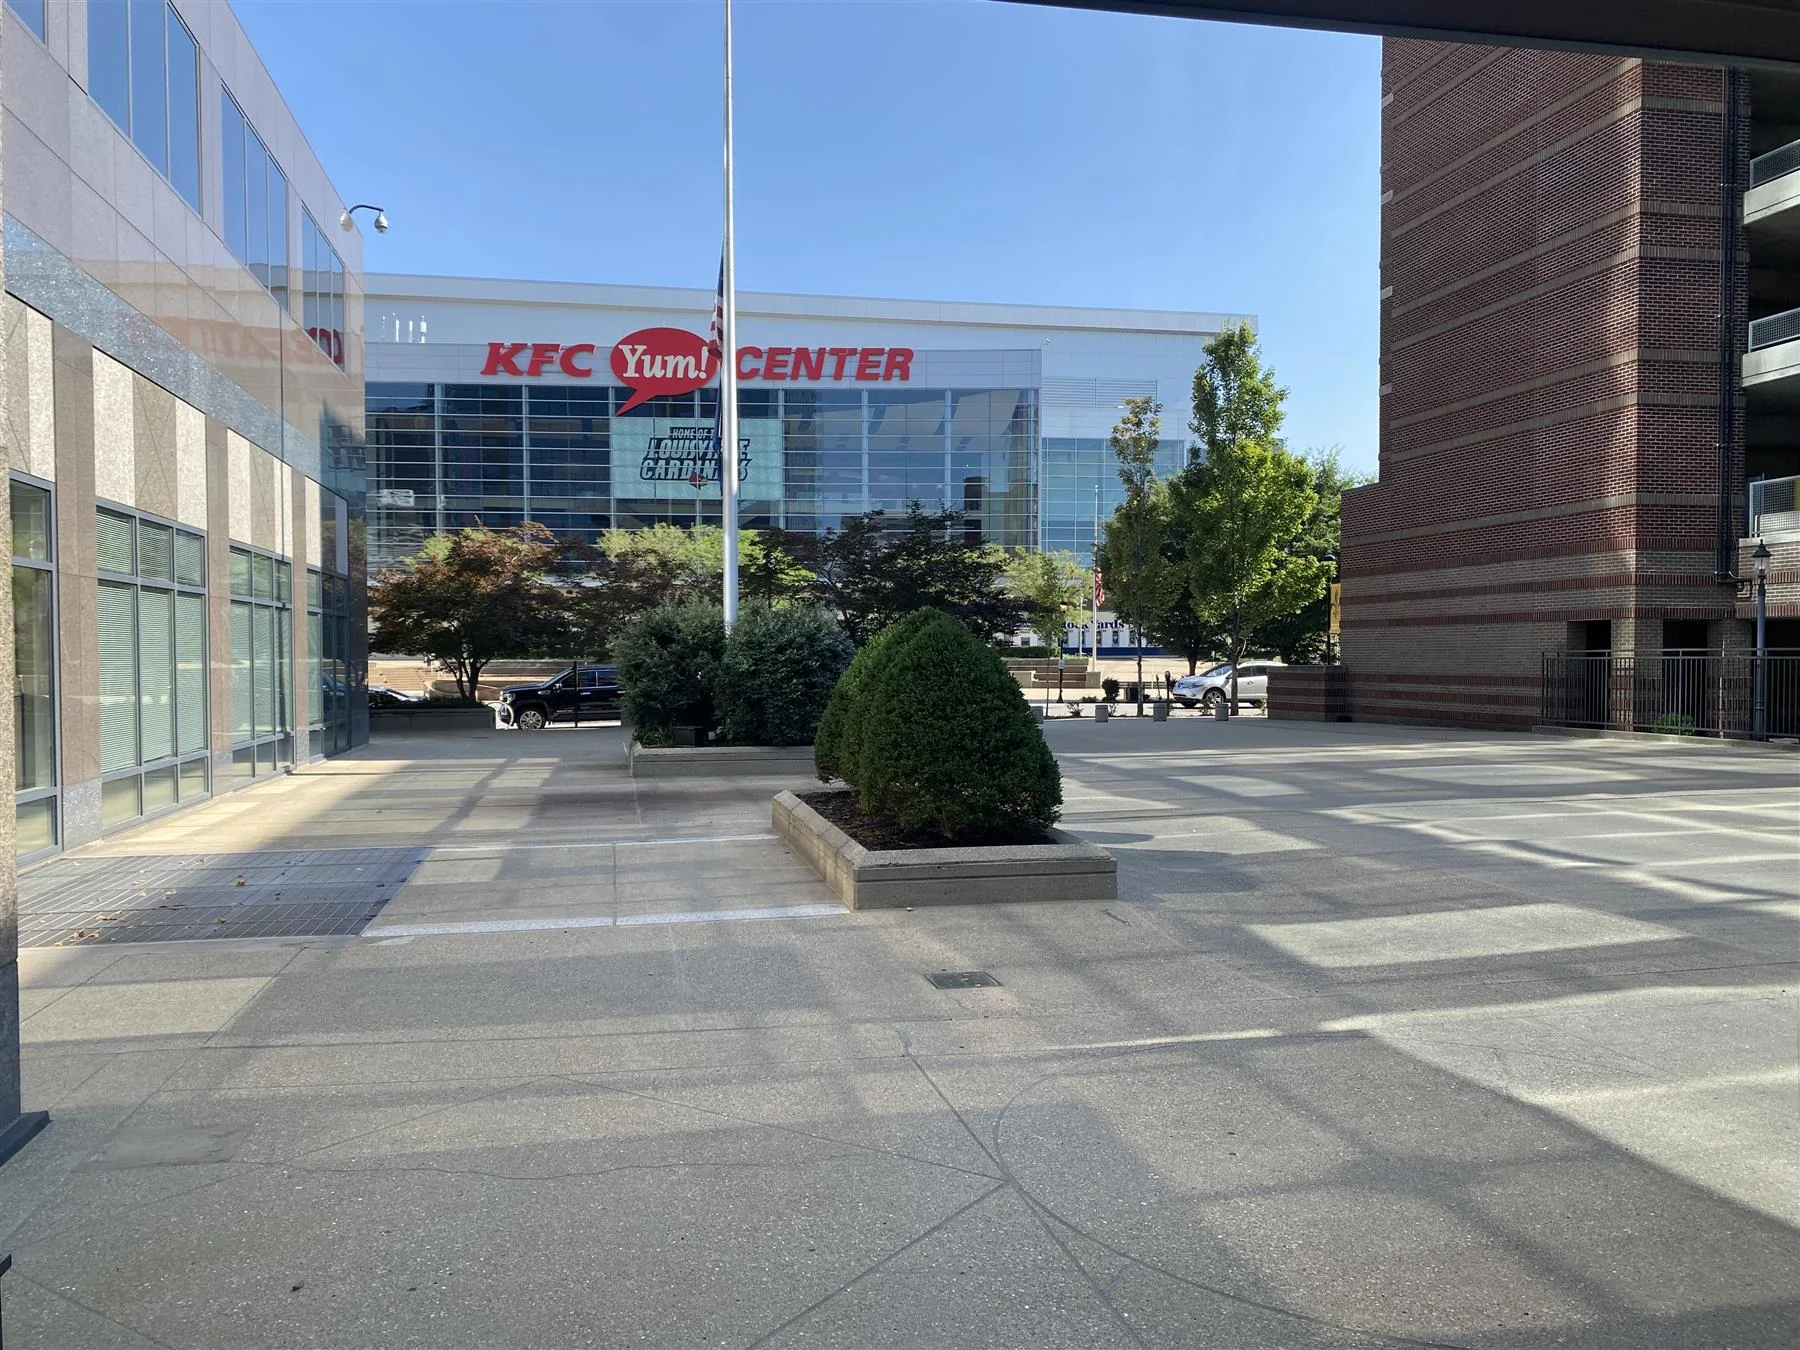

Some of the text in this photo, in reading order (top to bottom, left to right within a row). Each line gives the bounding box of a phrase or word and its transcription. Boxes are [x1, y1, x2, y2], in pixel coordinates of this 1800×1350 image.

[480, 342, 914, 381] KFC Yum! CENTER
[672, 428, 696, 438] HOME
[644, 438, 750, 459] LOUISVIE
[640, 459, 751, 480] CARDINS
